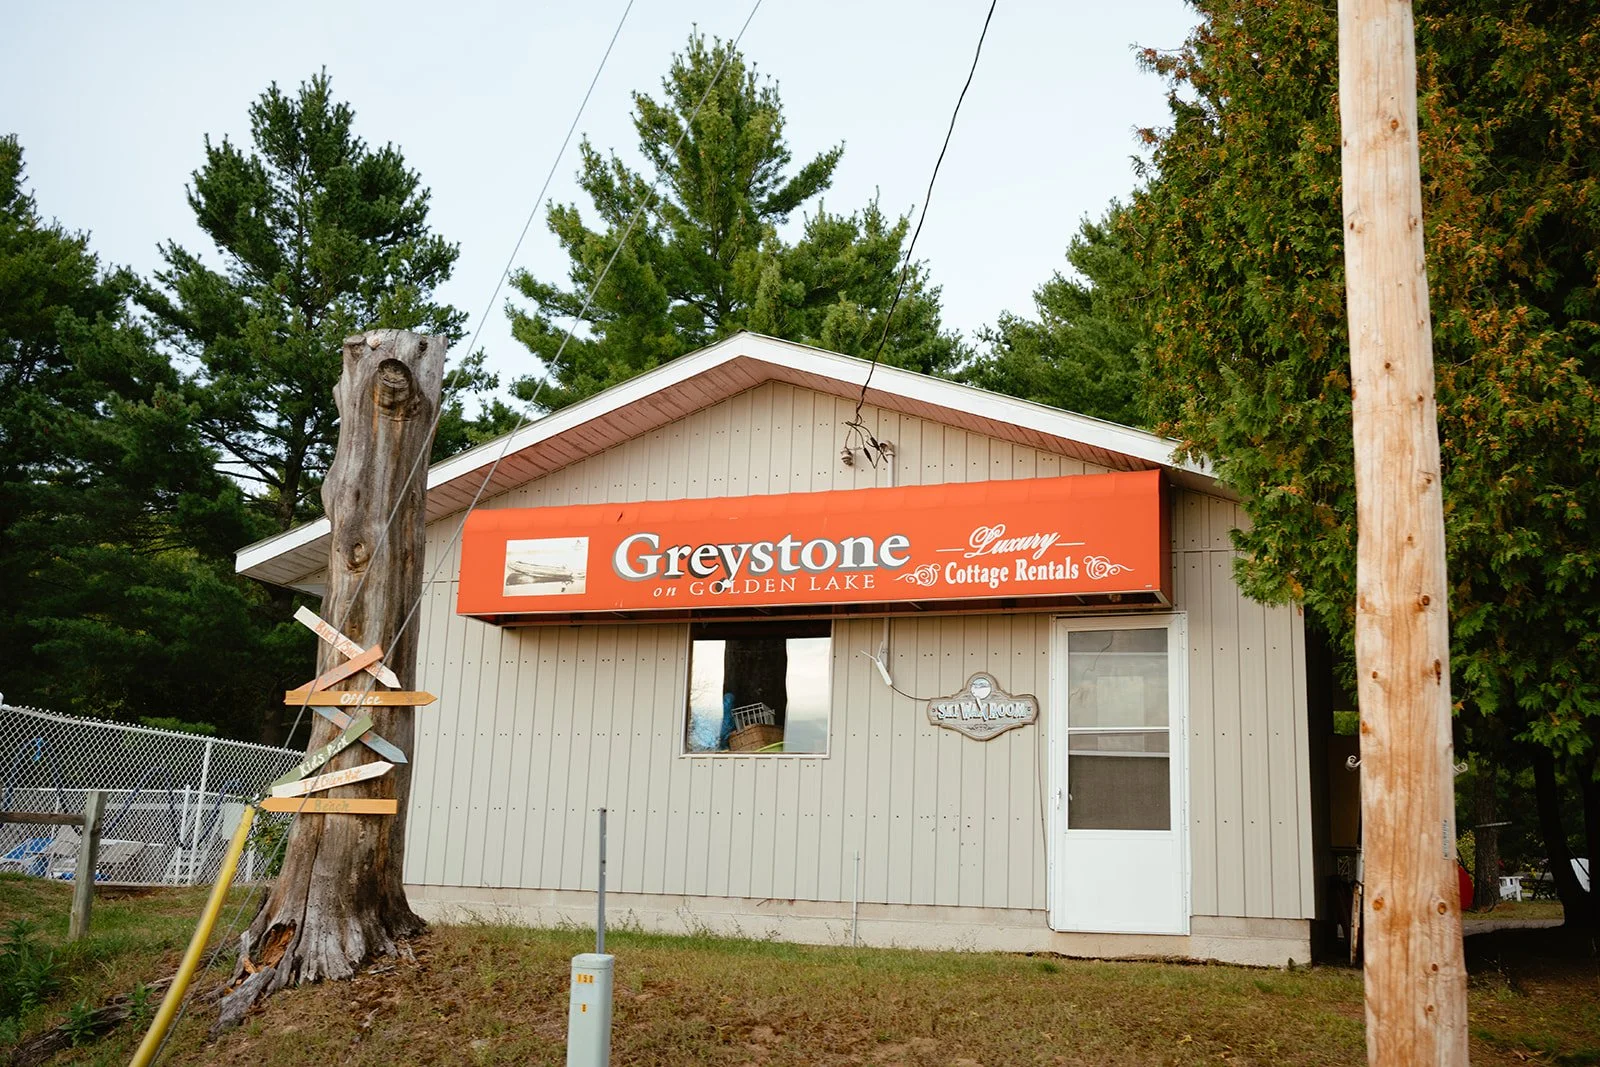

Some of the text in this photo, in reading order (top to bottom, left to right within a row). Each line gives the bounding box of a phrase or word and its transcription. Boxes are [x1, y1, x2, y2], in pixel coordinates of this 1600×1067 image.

[964, 524, 1060, 561] Luxury
[612, 532, 910, 592] Greystone
[944, 556, 1080, 589] Cottage Rentals
[653, 574, 876, 598] on GOLDEN LAKE
[340, 693, 383, 705] Office
[299, 751, 326, 778] Kids
